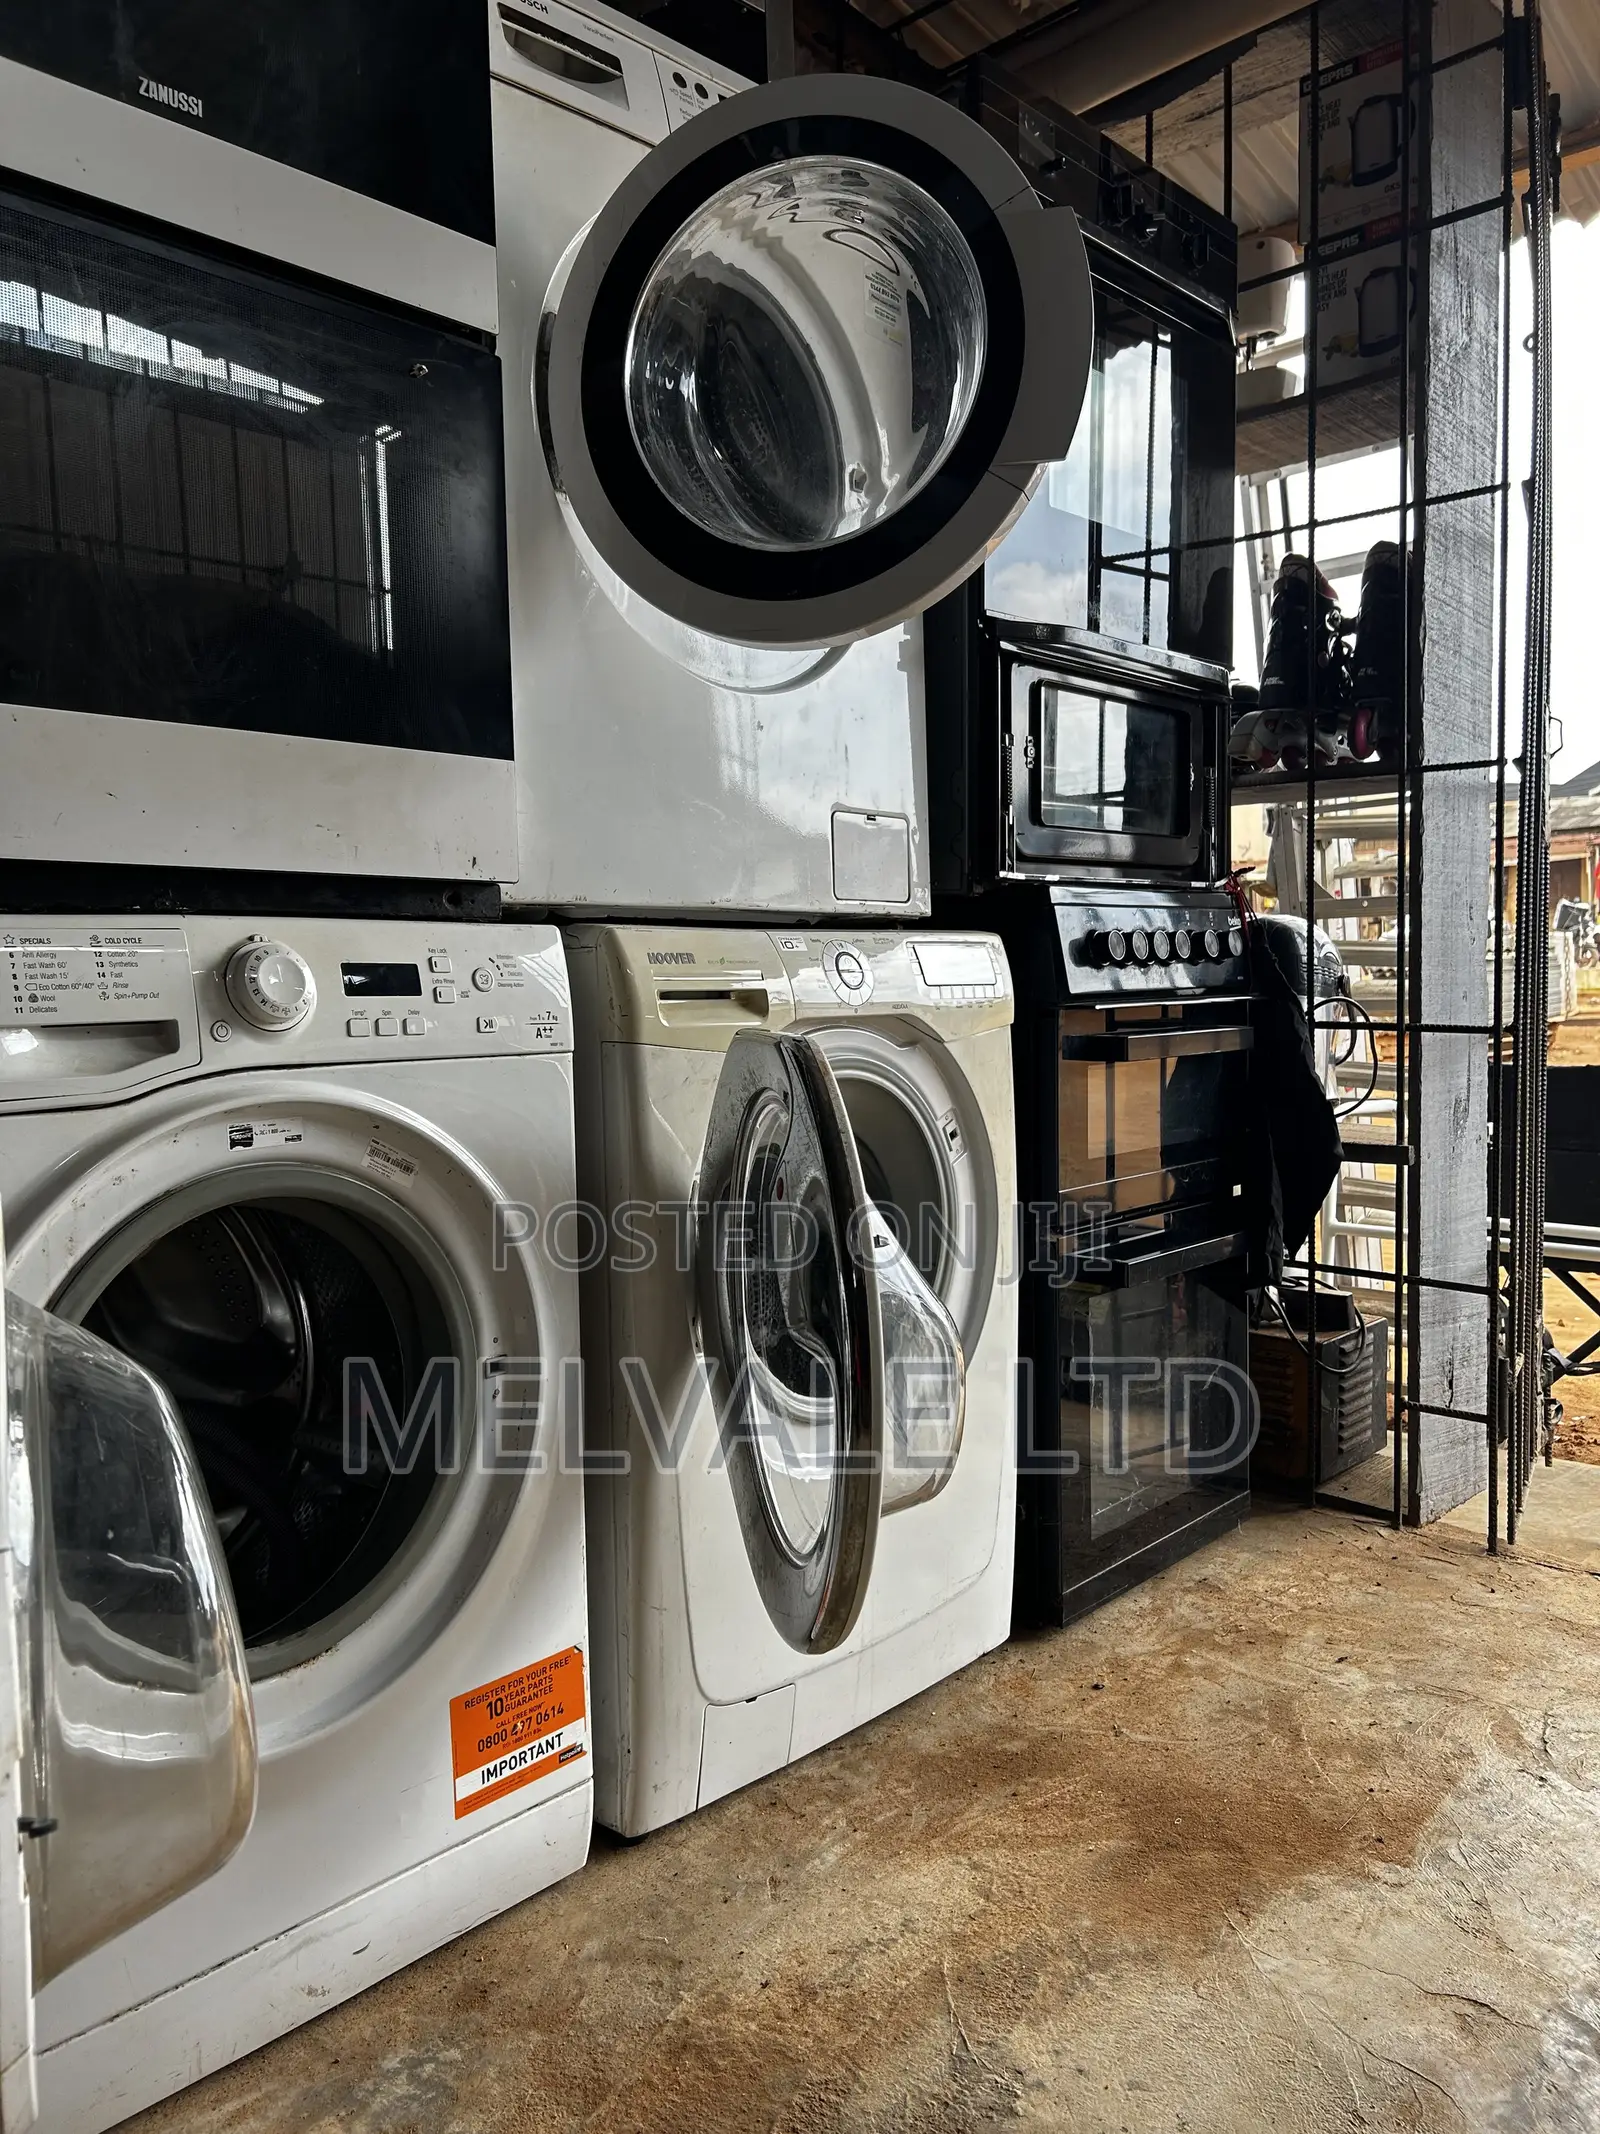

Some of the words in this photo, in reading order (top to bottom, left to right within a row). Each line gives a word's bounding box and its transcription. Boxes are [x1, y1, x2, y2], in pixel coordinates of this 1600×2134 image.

[1302, 64, 1354, 93] GEPAS
[138, 75, 203, 118] ZANUSSI
[1317, 234, 1360, 256] EEPAS
[19, 937, 52, 945] SPECIALS
[104, 937, 121, 945] COLD
[122, 937, 143, 945] CYCLE
[9, 951, 15, 959] 6
[36, 951, 57, 959] Allergy
[106, 950, 127, 958] Cotton
[646, 952, 697, 965] HOOVER
[38, 961, 56, 969] Wash
[108, 960, 139, 969] Synthetics
[24, 972, 38, 980] Fast
[112, 981, 129, 989] Rinse
[13, 995, 23, 1003] 10
[40, 994, 56, 1002] Wool
[113, 991, 149, 1000] Spin+Pump
[149, 991, 160, 999] Out
[14, 1006, 24, 1014] 11
[28, 1005, 58, 1014] Delicates
[407, 1009, 421, 1017] Delay
[545, 1010, 551, 1021] 7
[535, 1026, 554, 1039] A++
[464, 1684, 506, 1710] REGISTER
[507, 1676, 525, 1690] FOR
[525, 1666, 548, 1682] YOUR
[486, 1697, 504, 1720] 10
[504, 1687, 526, 1703] YEAR
[527, 1674, 553, 1691] PARTS
[504, 1684, 554, 1713] GUARANTEE
[496, 1717, 511, 1729] CALL
[512, 1710, 528, 1722] FREE
[477, 1728, 508, 1753] 0800
[536, 1701, 564, 1725] 0614
[481, 1732, 564, 1785] IMPORTANT
